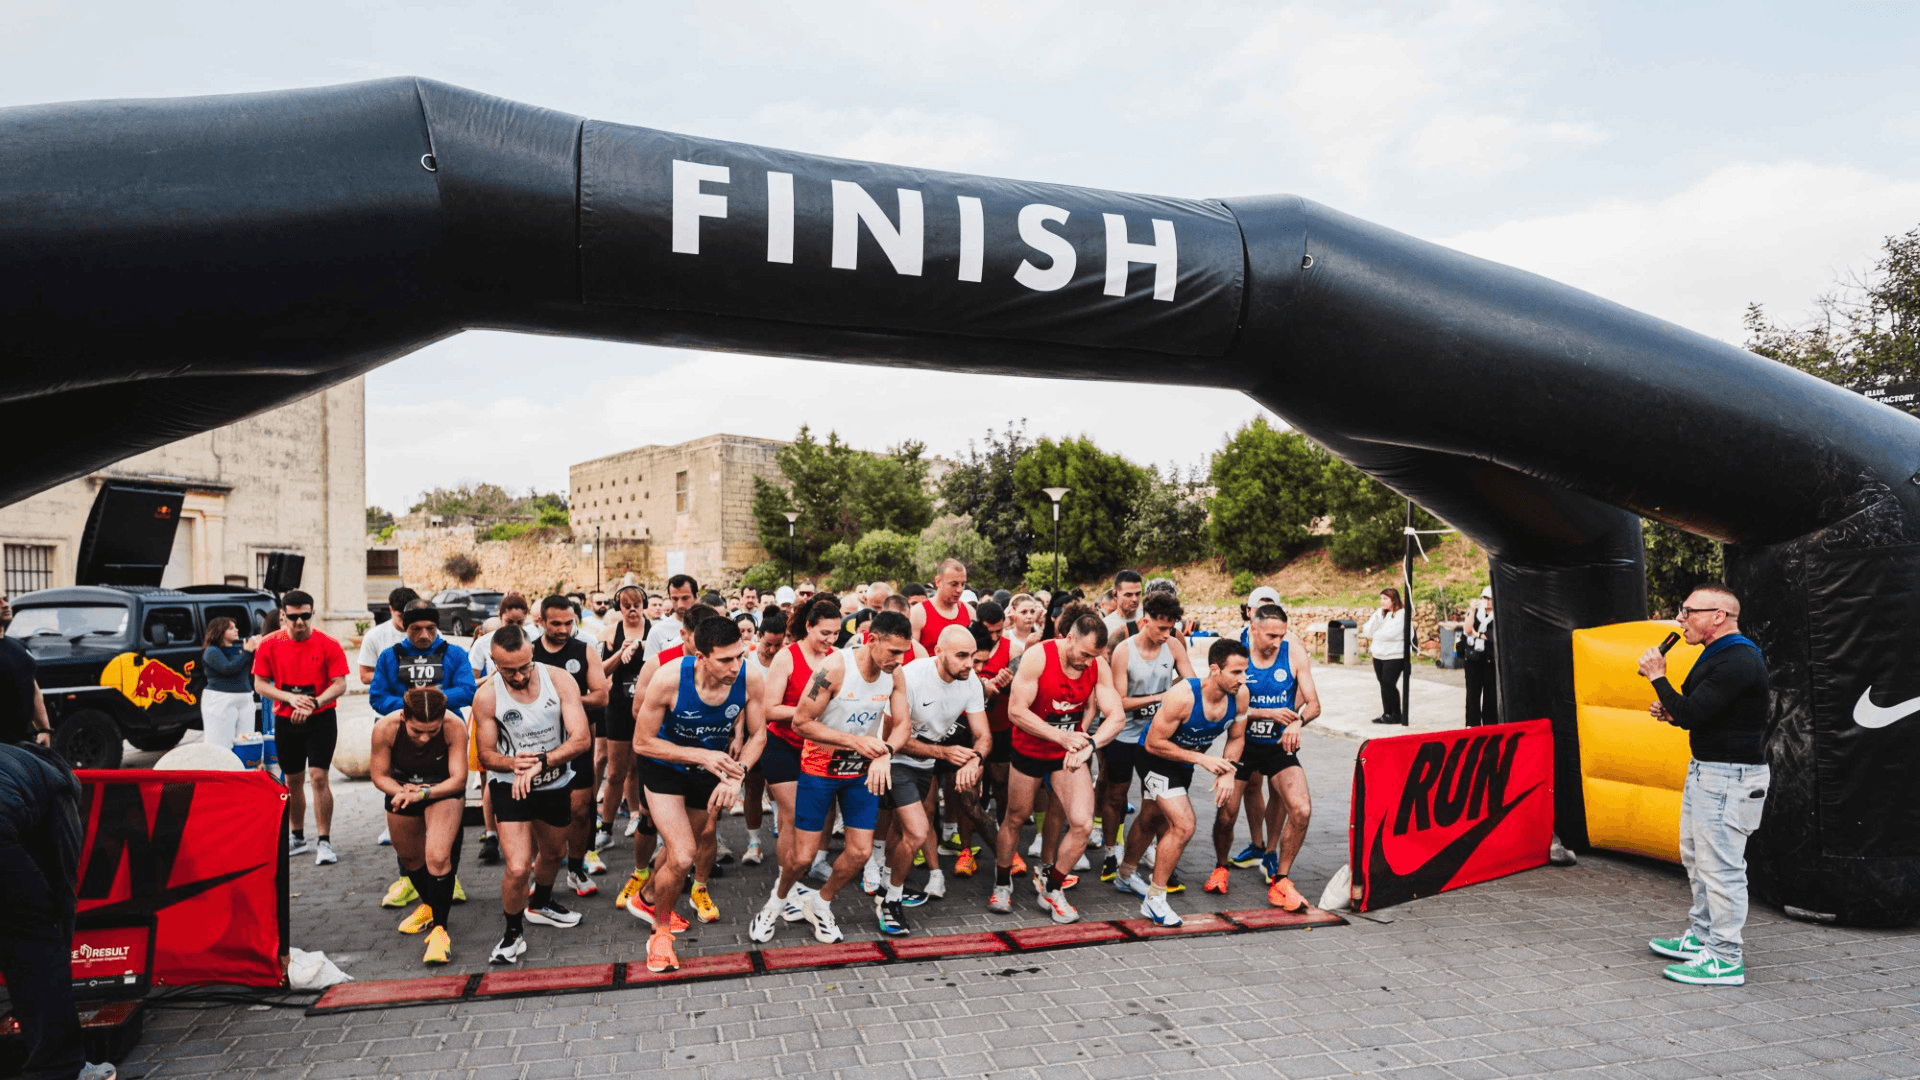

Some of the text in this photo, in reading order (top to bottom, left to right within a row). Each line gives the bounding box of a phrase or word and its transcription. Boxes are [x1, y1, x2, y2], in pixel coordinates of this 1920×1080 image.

[672, 159, 1178, 302] FINISH
[408, 666, 435, 679] 170
[1250, 694, 1288, 704] ARMIN
[846, 711, 877, 726] AQA
[1250, 721, 1275, 734] 457
[1393, 732, 1525, 837] RUN
[93, 946, 130, 958] RESULT
